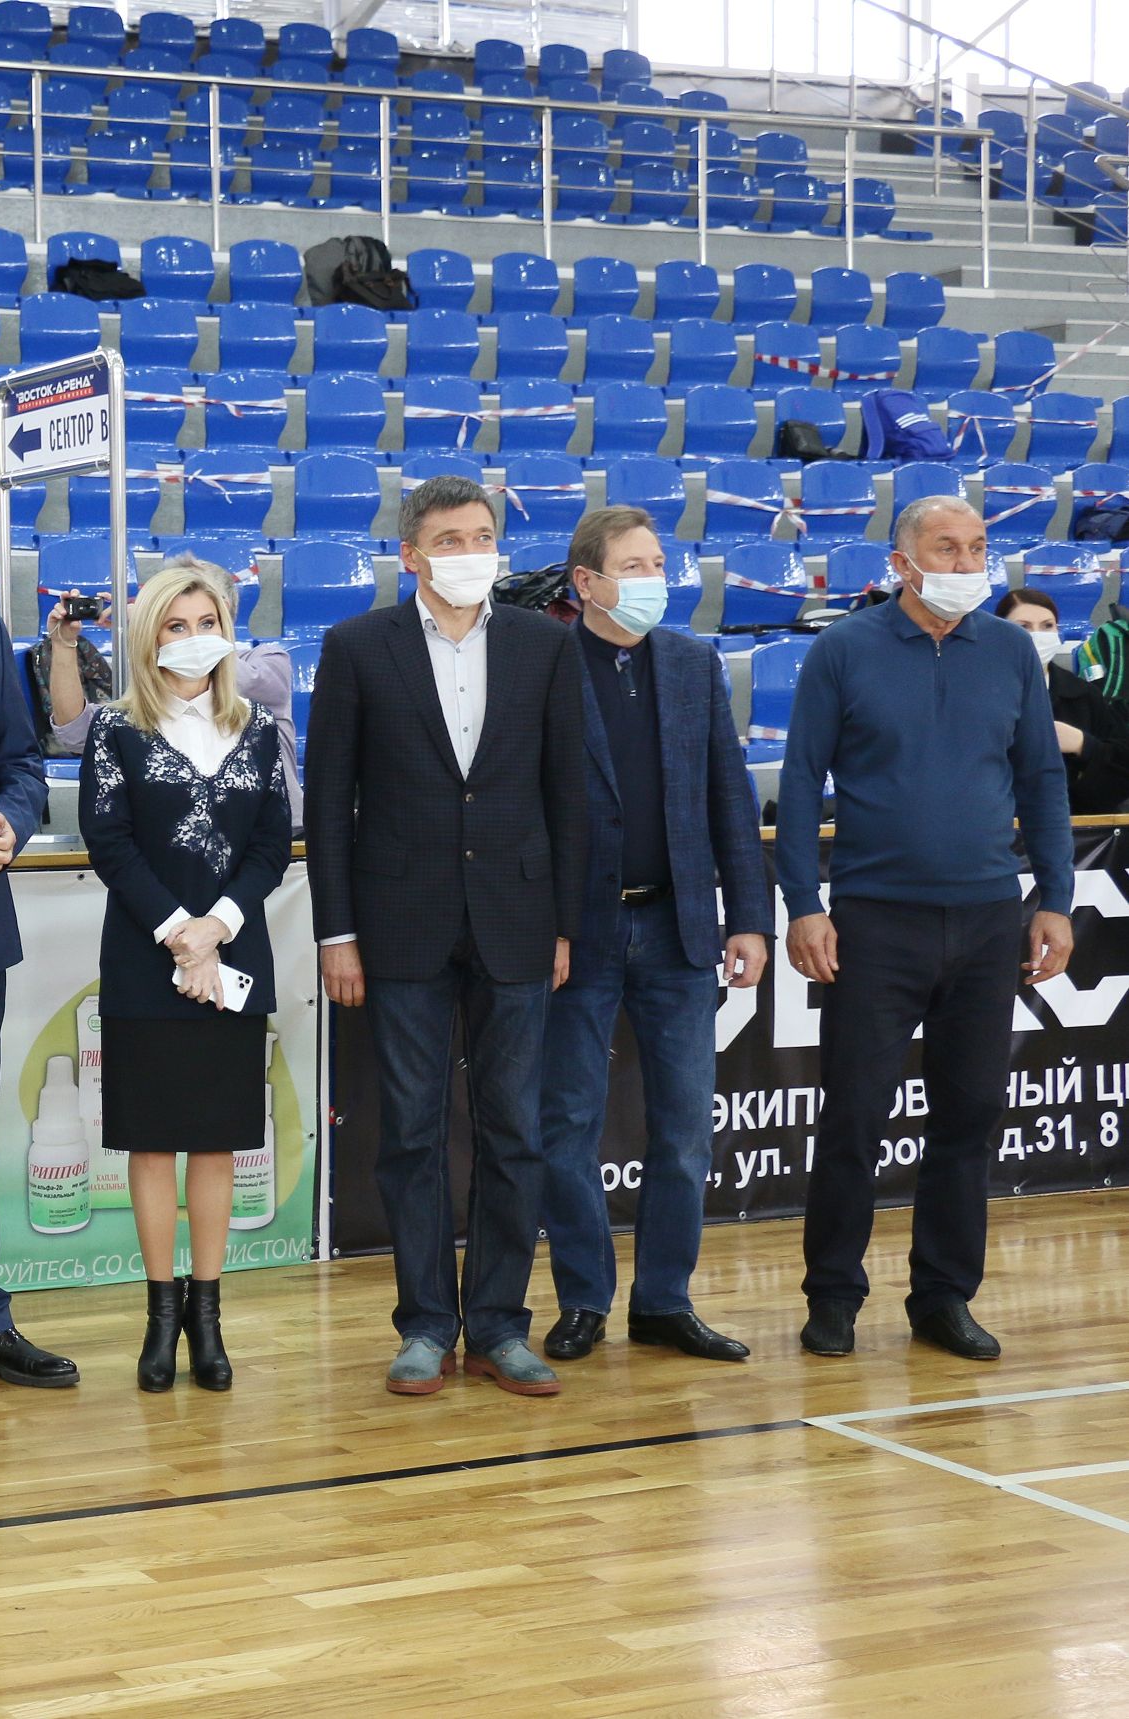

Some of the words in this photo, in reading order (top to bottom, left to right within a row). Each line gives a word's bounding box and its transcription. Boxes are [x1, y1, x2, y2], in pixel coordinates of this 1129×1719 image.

[49, 412, 94, 452] СЕКТОР
[734, 1148, 791, 1189] ул.
[998, 1114, 1087, 1162] д.31,
[1100, 1111, 1119, 1148] 8
[92, 1255, 123, 1276] СО
